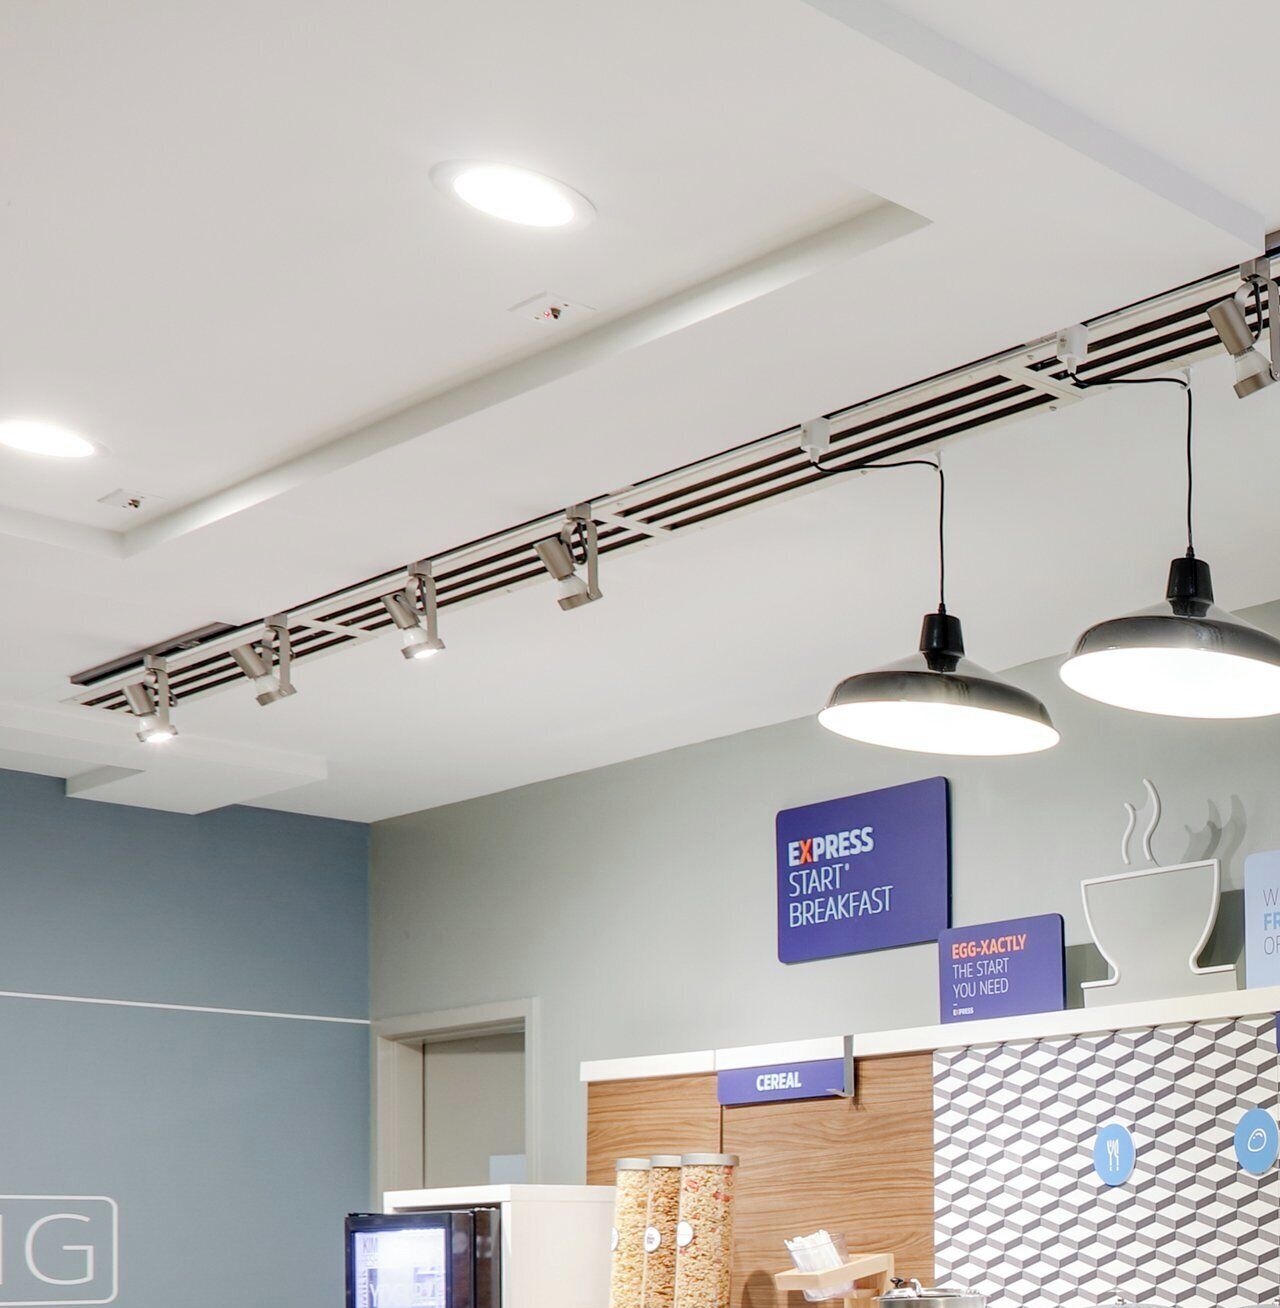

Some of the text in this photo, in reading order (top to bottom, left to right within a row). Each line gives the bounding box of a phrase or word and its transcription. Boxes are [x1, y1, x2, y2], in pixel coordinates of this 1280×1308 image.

[788, 826, 874, 867] EXPRESS
[789, 885, 894, 928] BREAKFAST
[952, 933, 1027, 959] EGG-XACTLY
[952, 957, 1010, 979] THE START
[953, 978, 1009, 999] YOU NEED
[756, 1071, 802, 1091] CEREAL
